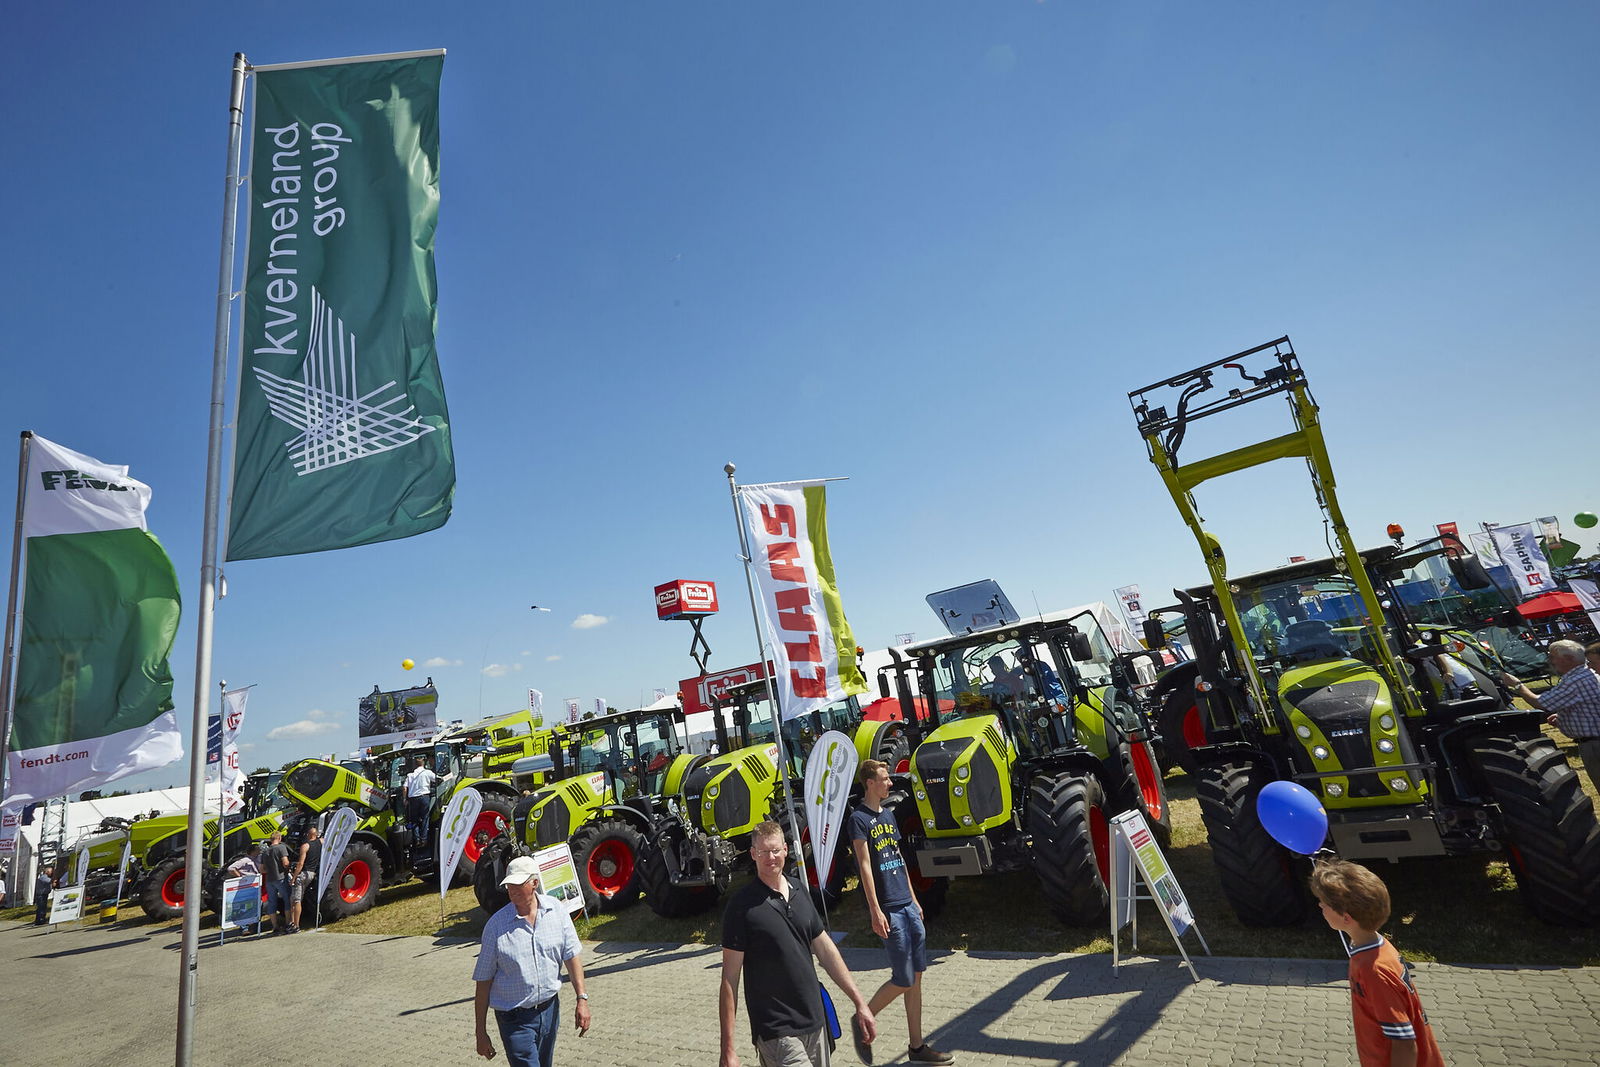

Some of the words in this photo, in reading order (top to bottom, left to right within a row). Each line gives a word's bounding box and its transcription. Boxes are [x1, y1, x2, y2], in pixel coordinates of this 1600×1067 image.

[311, 122, 352, 237] group
[253, 121, 301, 355] kverneland
[759, 503, 828, 698] CLAAS
[1510, 531, 1536, 573] SAPHIR
[20, 750, 89, 769] fendt.com
